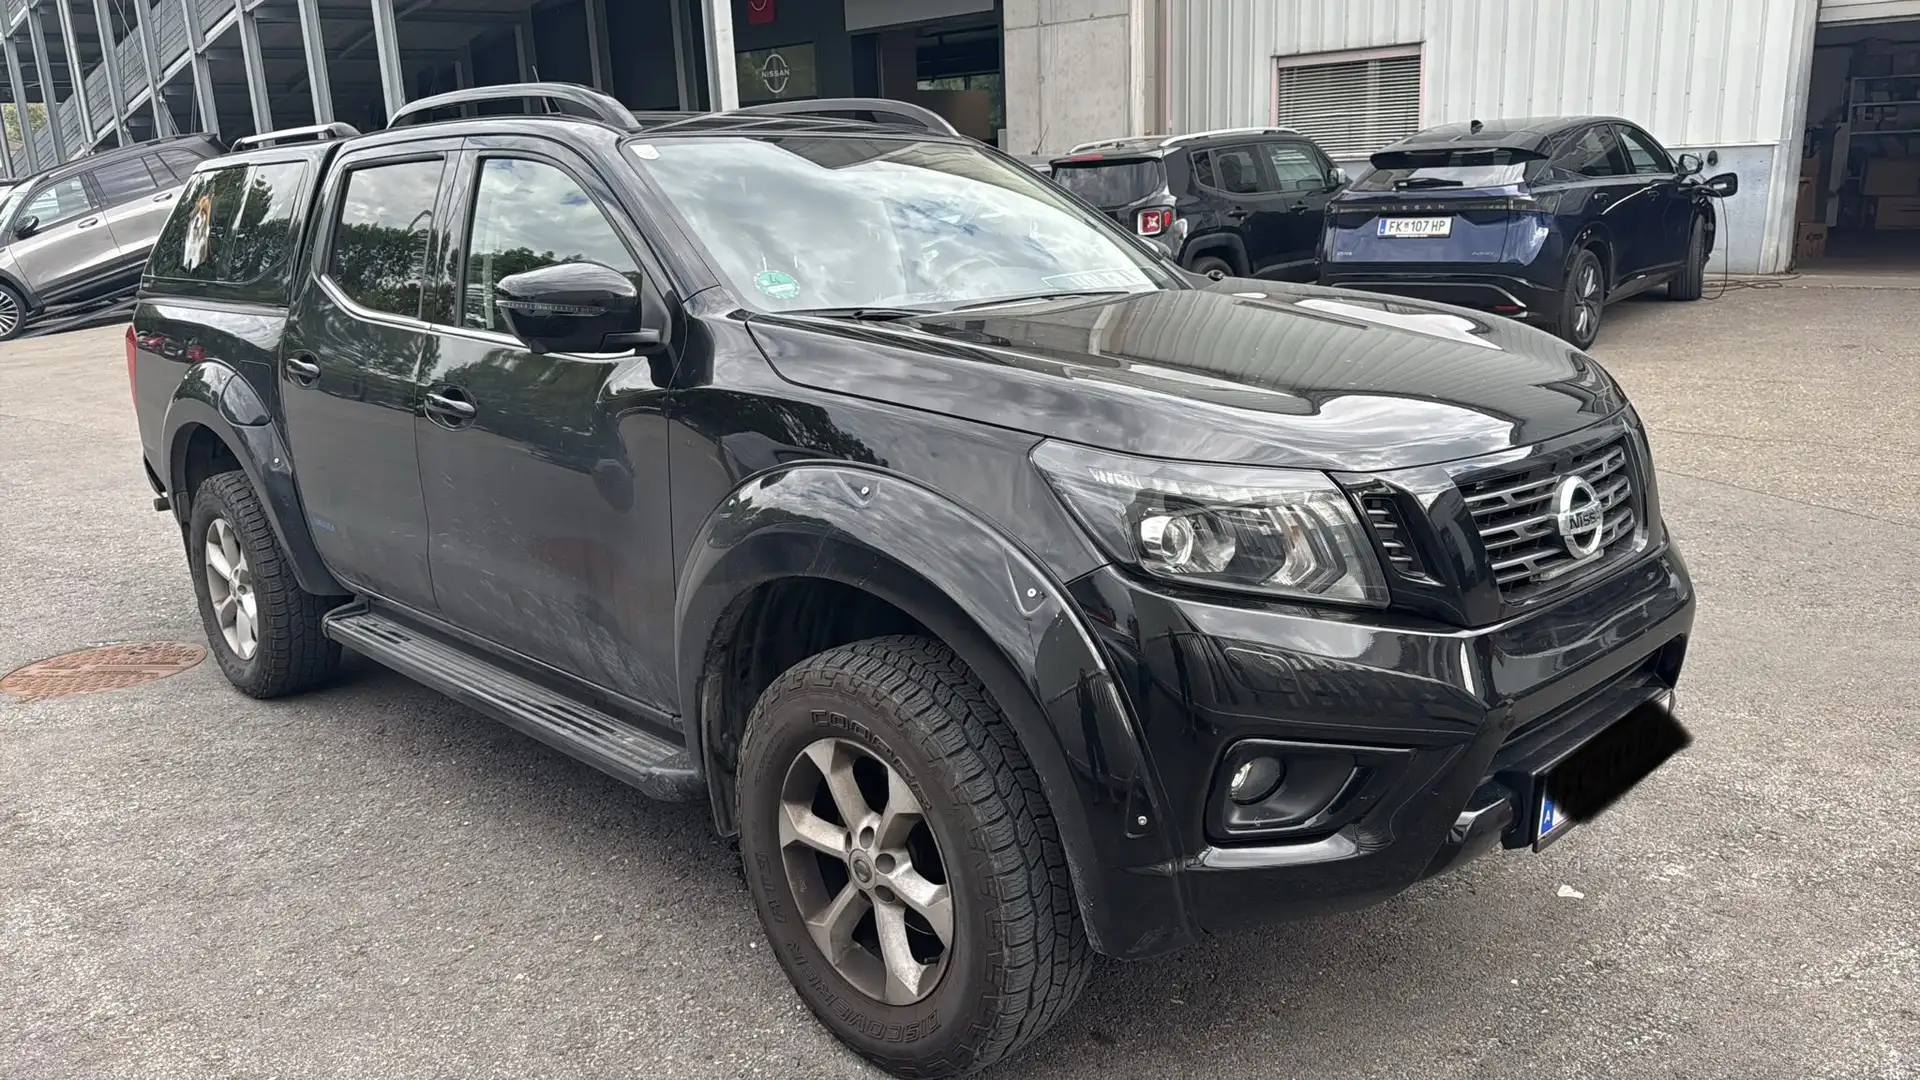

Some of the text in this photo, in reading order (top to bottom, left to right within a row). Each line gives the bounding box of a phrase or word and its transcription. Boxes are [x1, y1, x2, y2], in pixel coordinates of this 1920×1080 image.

[761, 69, 790, 78] NISSAN
[1381, 203, 1445, 212] NISSAN
[1388, 220, 1446, 233] FK 107 HP
[1543, 809, 1552, 824] A
